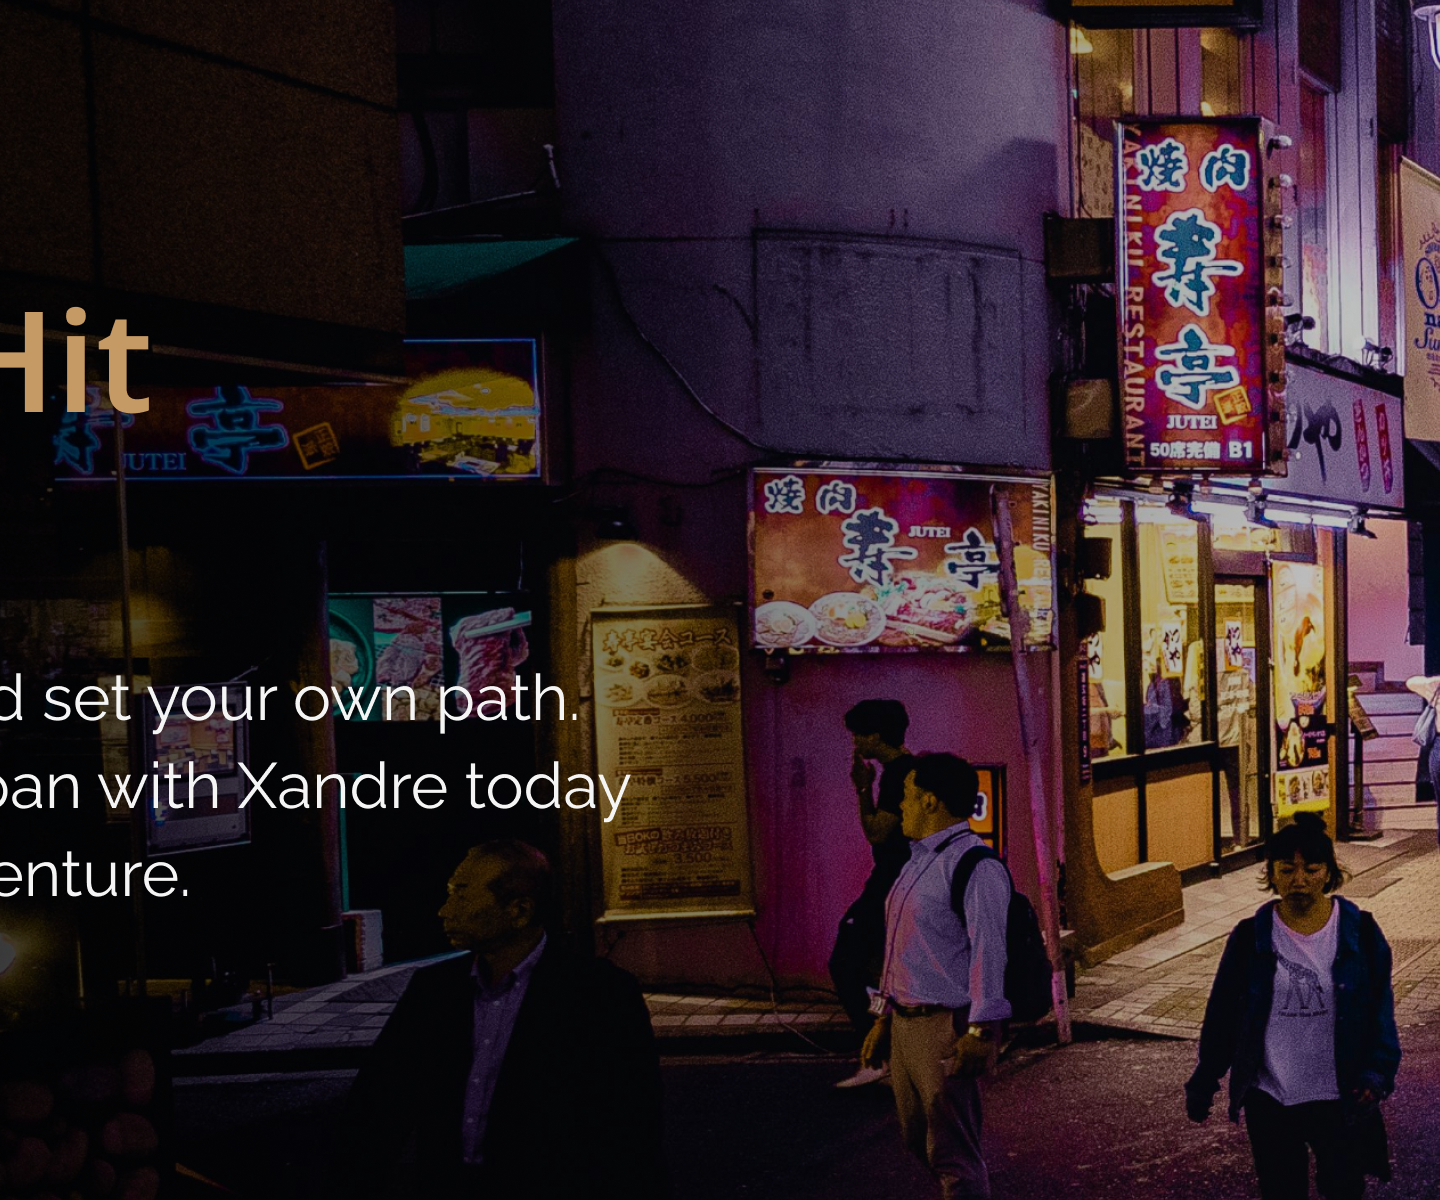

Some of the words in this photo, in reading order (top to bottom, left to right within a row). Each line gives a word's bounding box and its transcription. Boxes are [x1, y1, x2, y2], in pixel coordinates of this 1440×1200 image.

[1136, 137, 1250, 193] 焼肉
[1122, 124, 1144, 268] YAKINIKU
[1124, 286, 1146, 467] RESTAURANT
[1166, 414, 1218, 430] JUTEI
[1228, 441, 1253, 460] B1
[764, 475, 857, 514] 焼肉
[1032, 484, 1051, 551] YAKINIKU
[908, 525, 952, 538] JUTEI
